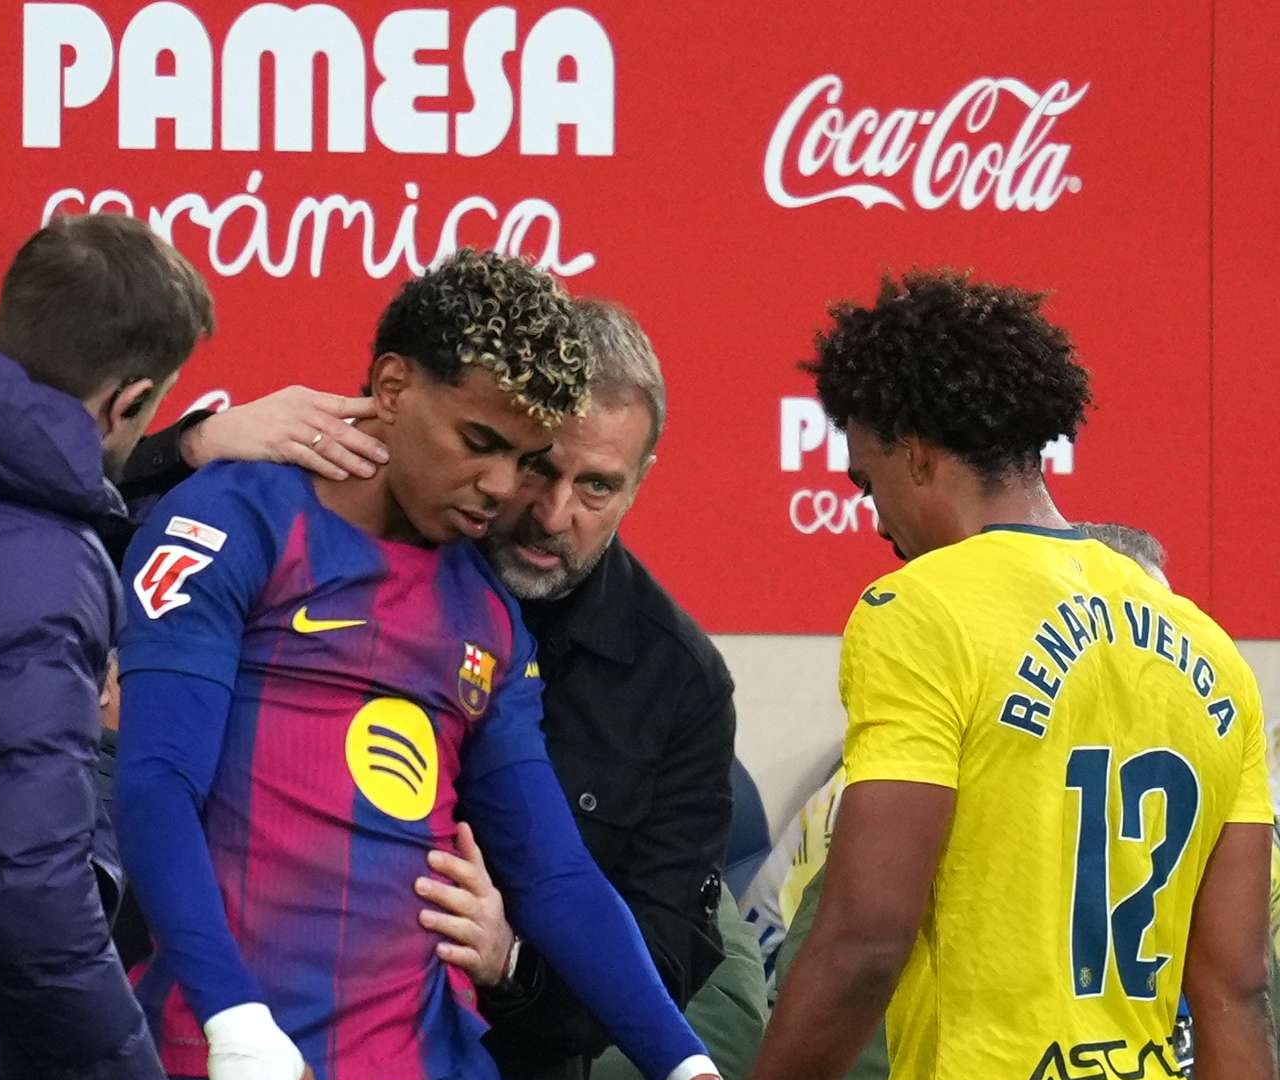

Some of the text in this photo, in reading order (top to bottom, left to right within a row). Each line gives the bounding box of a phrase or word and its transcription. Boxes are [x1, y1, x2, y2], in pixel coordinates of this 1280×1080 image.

[22, 1, 615, 158] PAMESA
[763, 74, 1090, 212] Coca-Cola
[998, 594, 1237, 739] RENATO VEIGA
[1065, 745, 1202, 1001] 12
